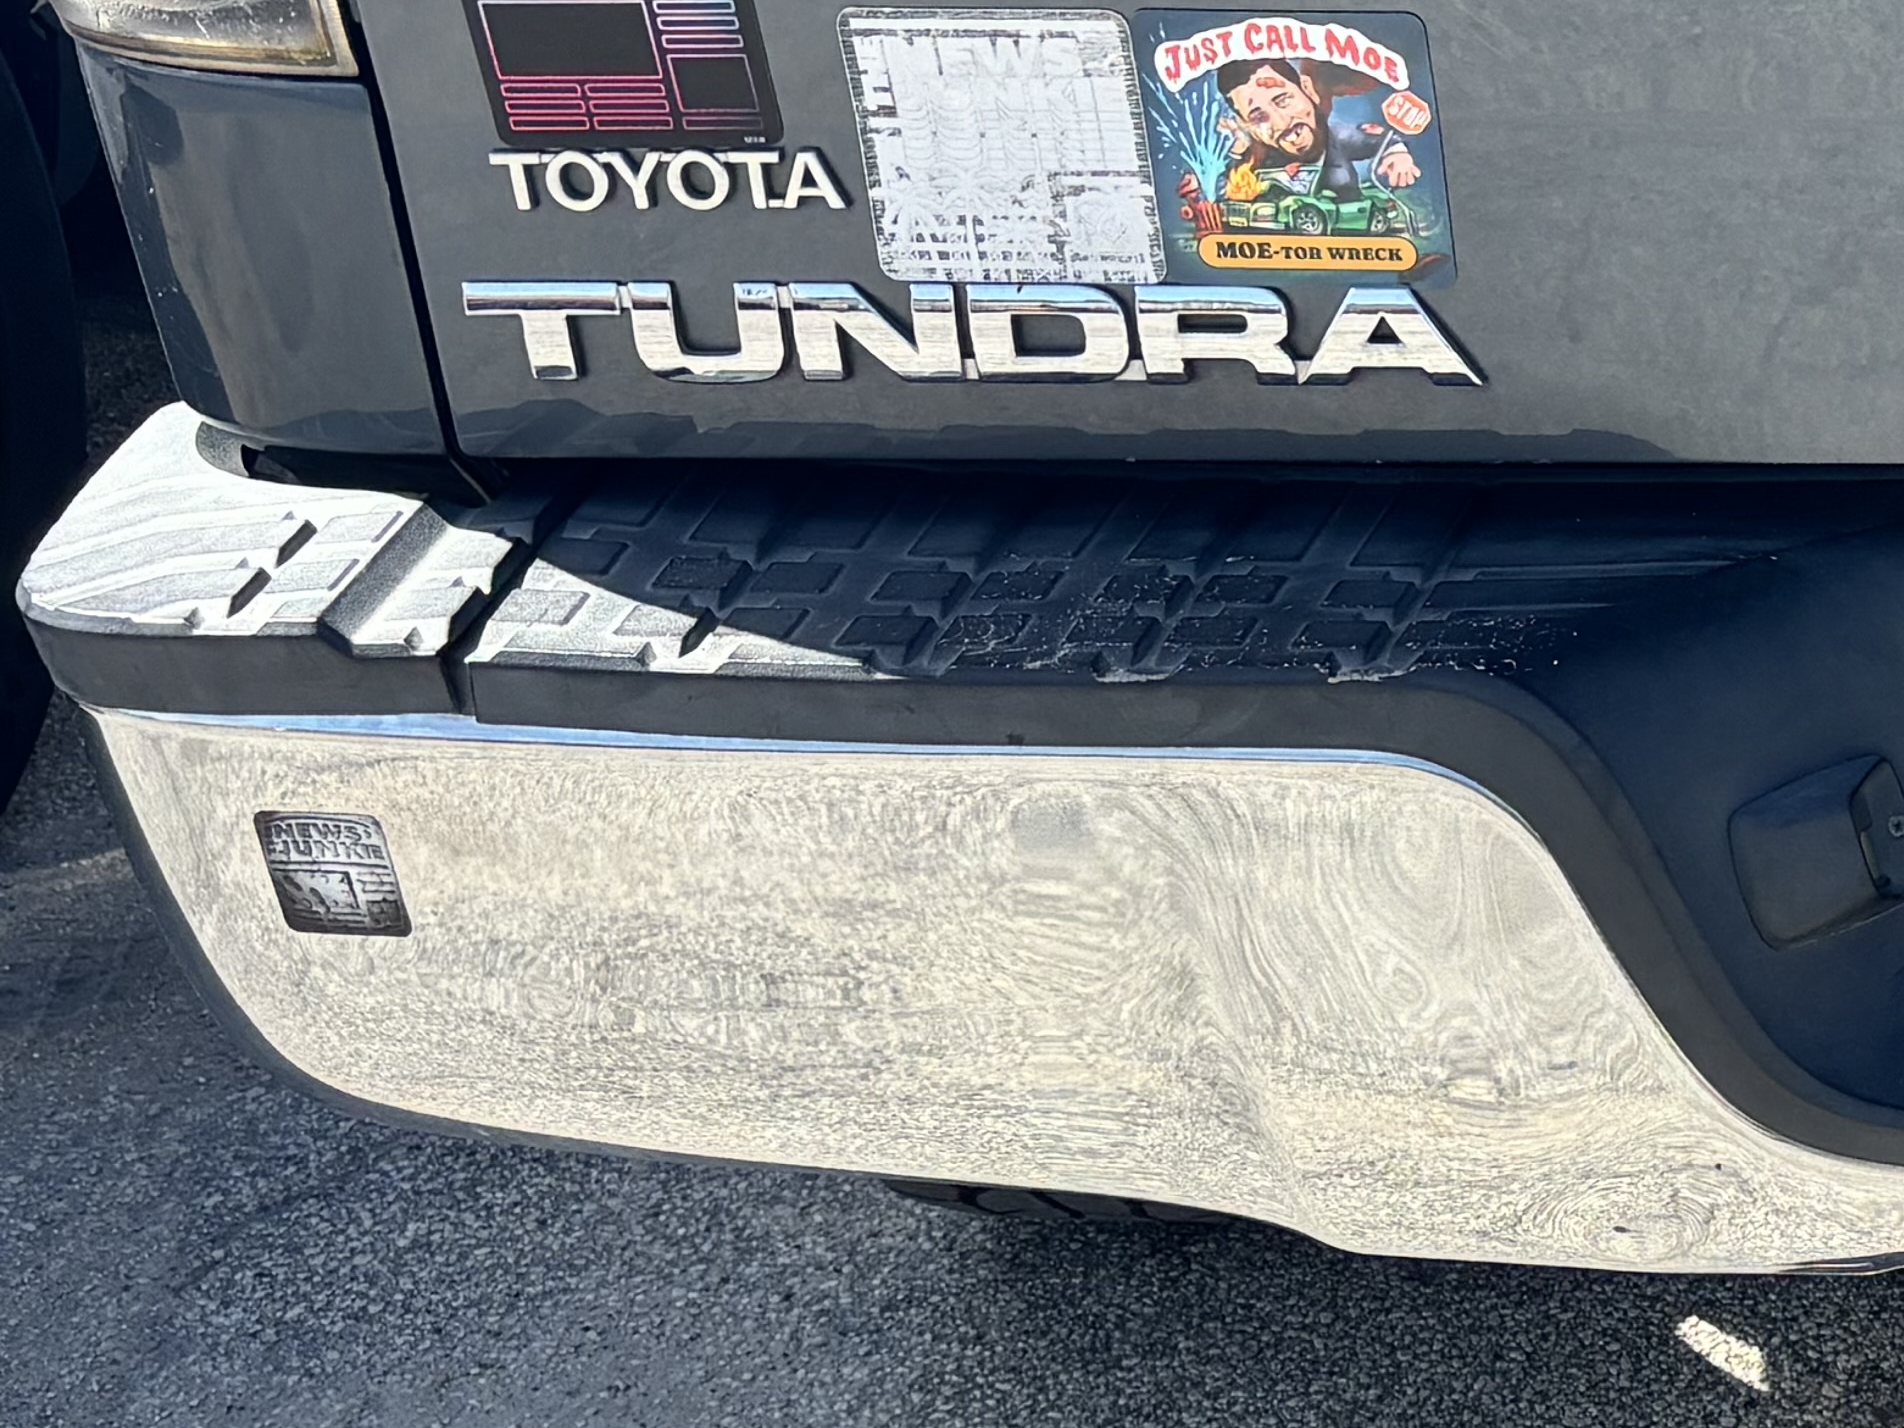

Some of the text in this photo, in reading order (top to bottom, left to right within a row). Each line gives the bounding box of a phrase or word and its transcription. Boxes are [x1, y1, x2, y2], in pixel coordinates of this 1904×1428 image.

[1164, 23, 1400, 84] JUST CALL MOE
[1389, 95, 1427, 129] STOP
[488, 147, 850, 213] TOYOTA
[1216, 241, 1404, 262] MOE-TOR WRECK
[462, 283, 1484, 386] TUNDRA
[270, 823, 363, 841] NEWS
